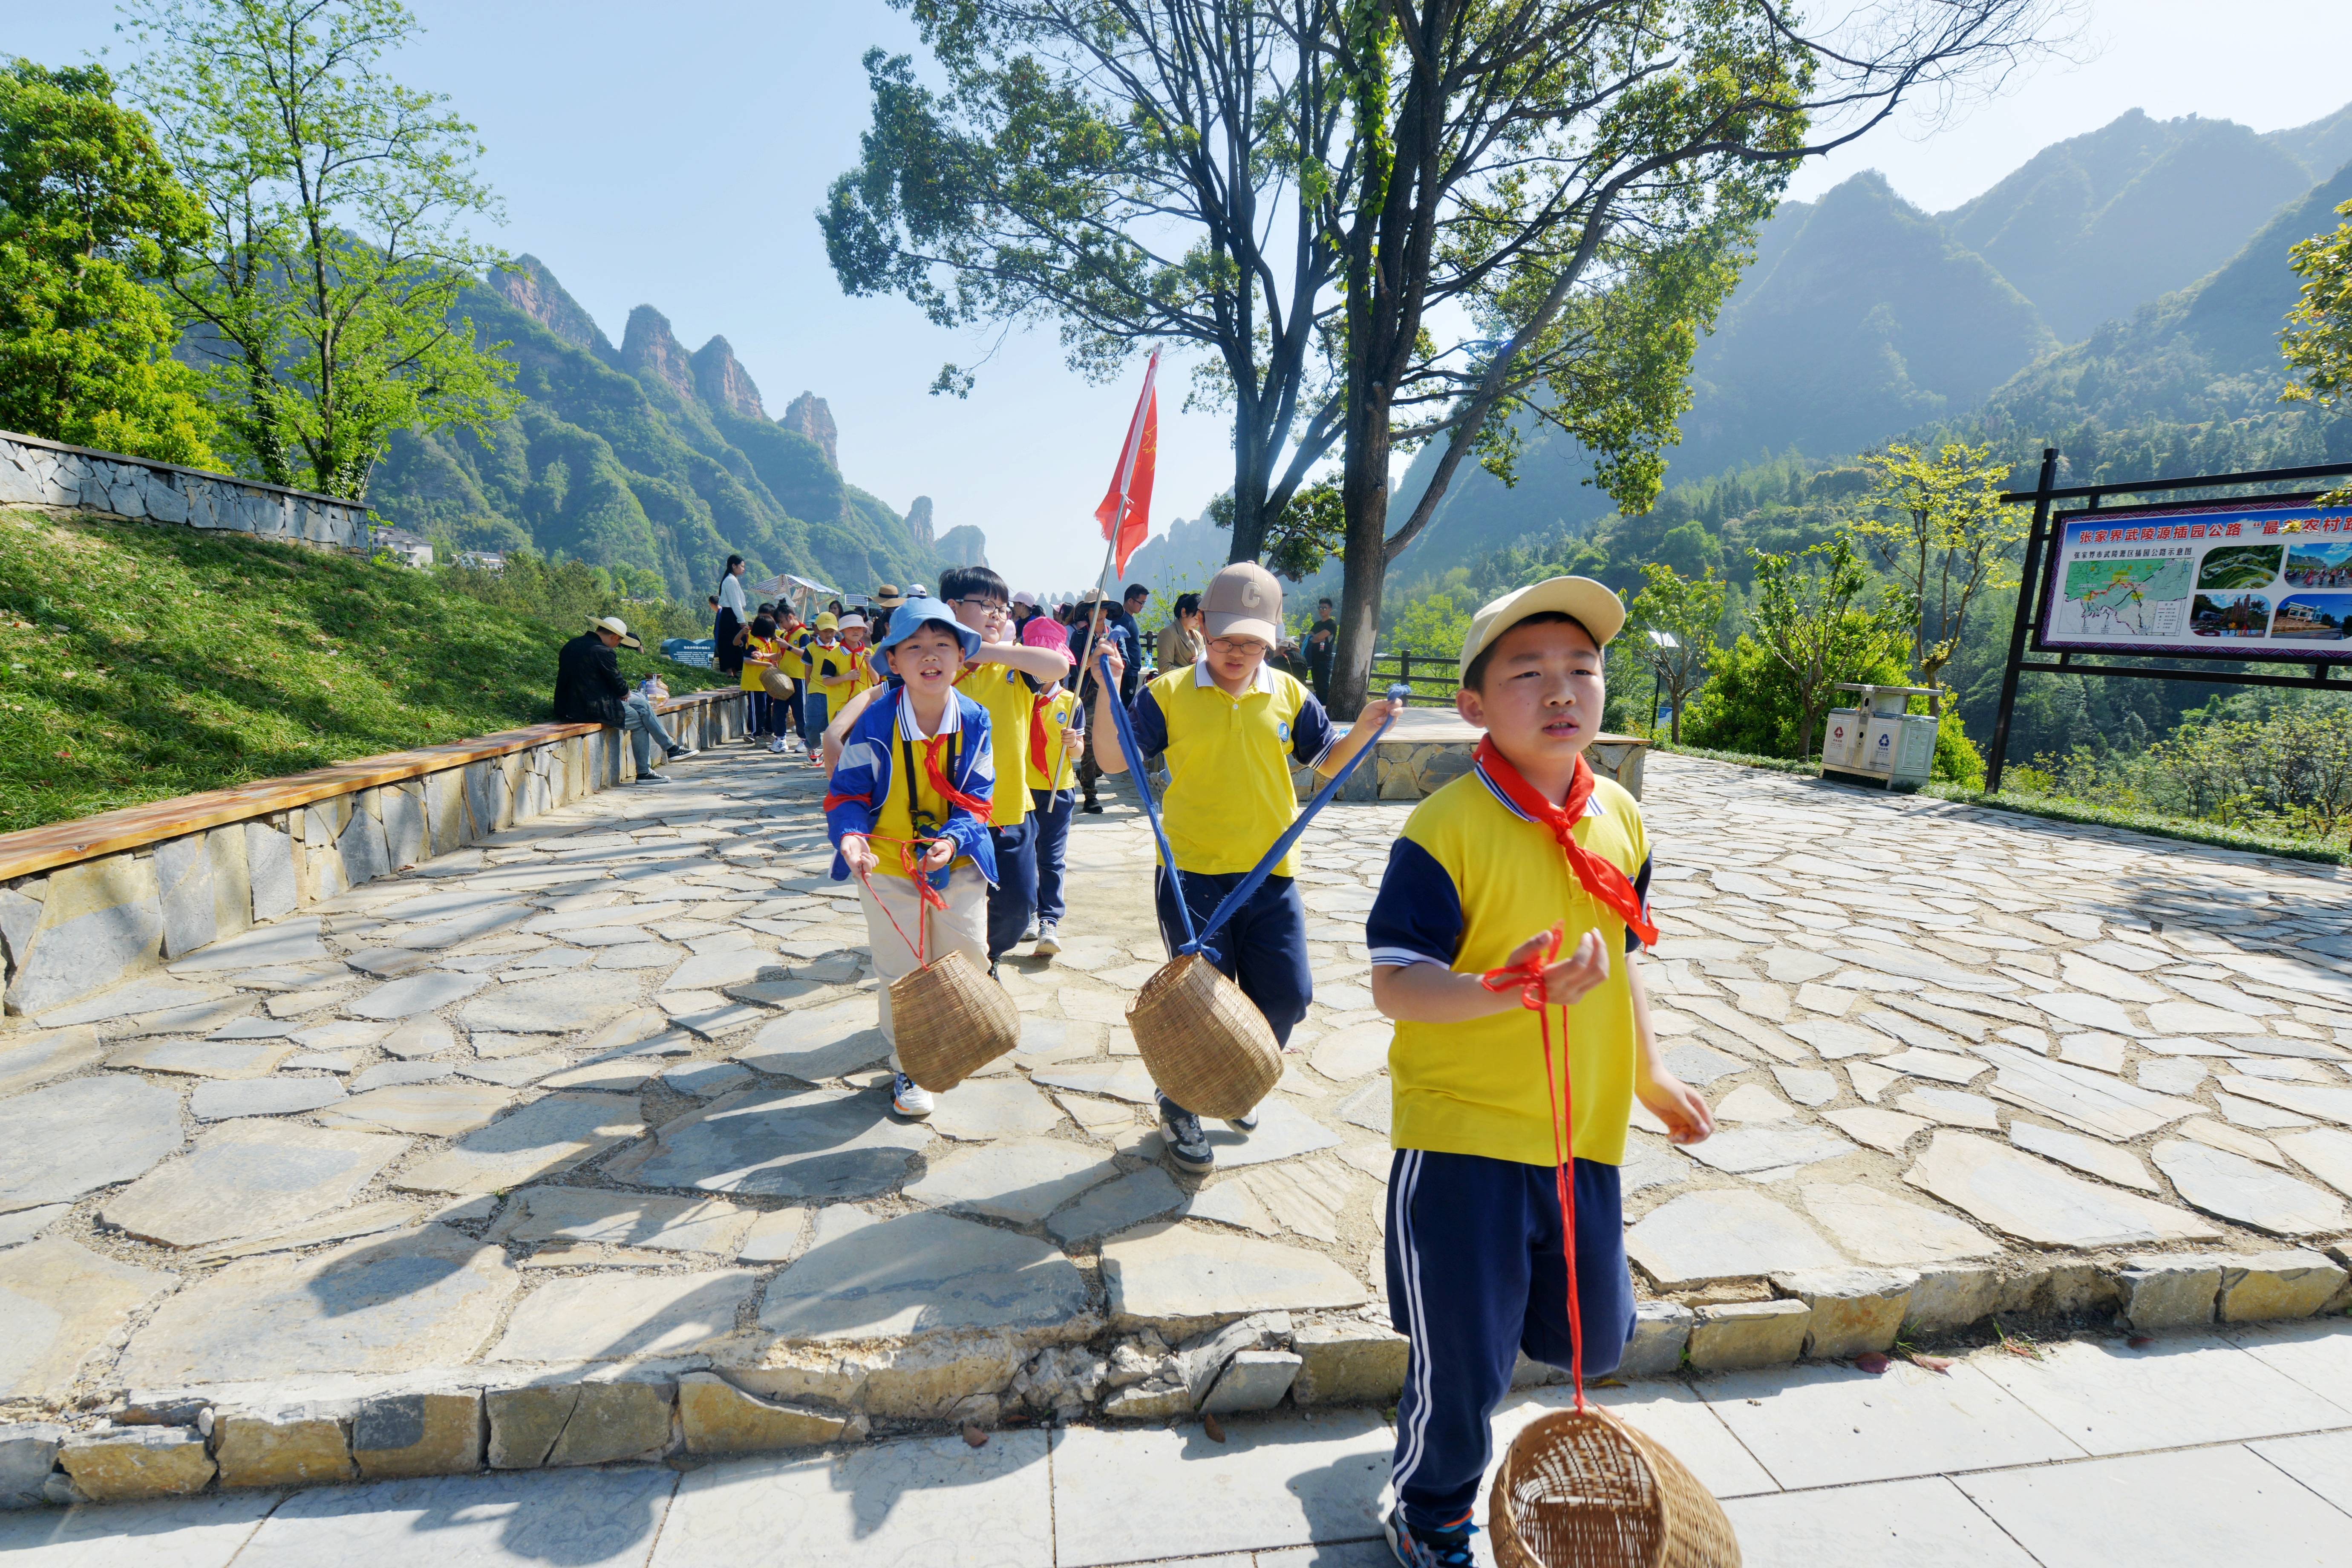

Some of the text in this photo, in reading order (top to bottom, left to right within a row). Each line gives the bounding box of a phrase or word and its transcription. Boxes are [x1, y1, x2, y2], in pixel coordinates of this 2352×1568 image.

[2074, 547, 2192, 559] 张家界市武陵源区插园公路示意图
[1241, 581, 1261, 608] C
